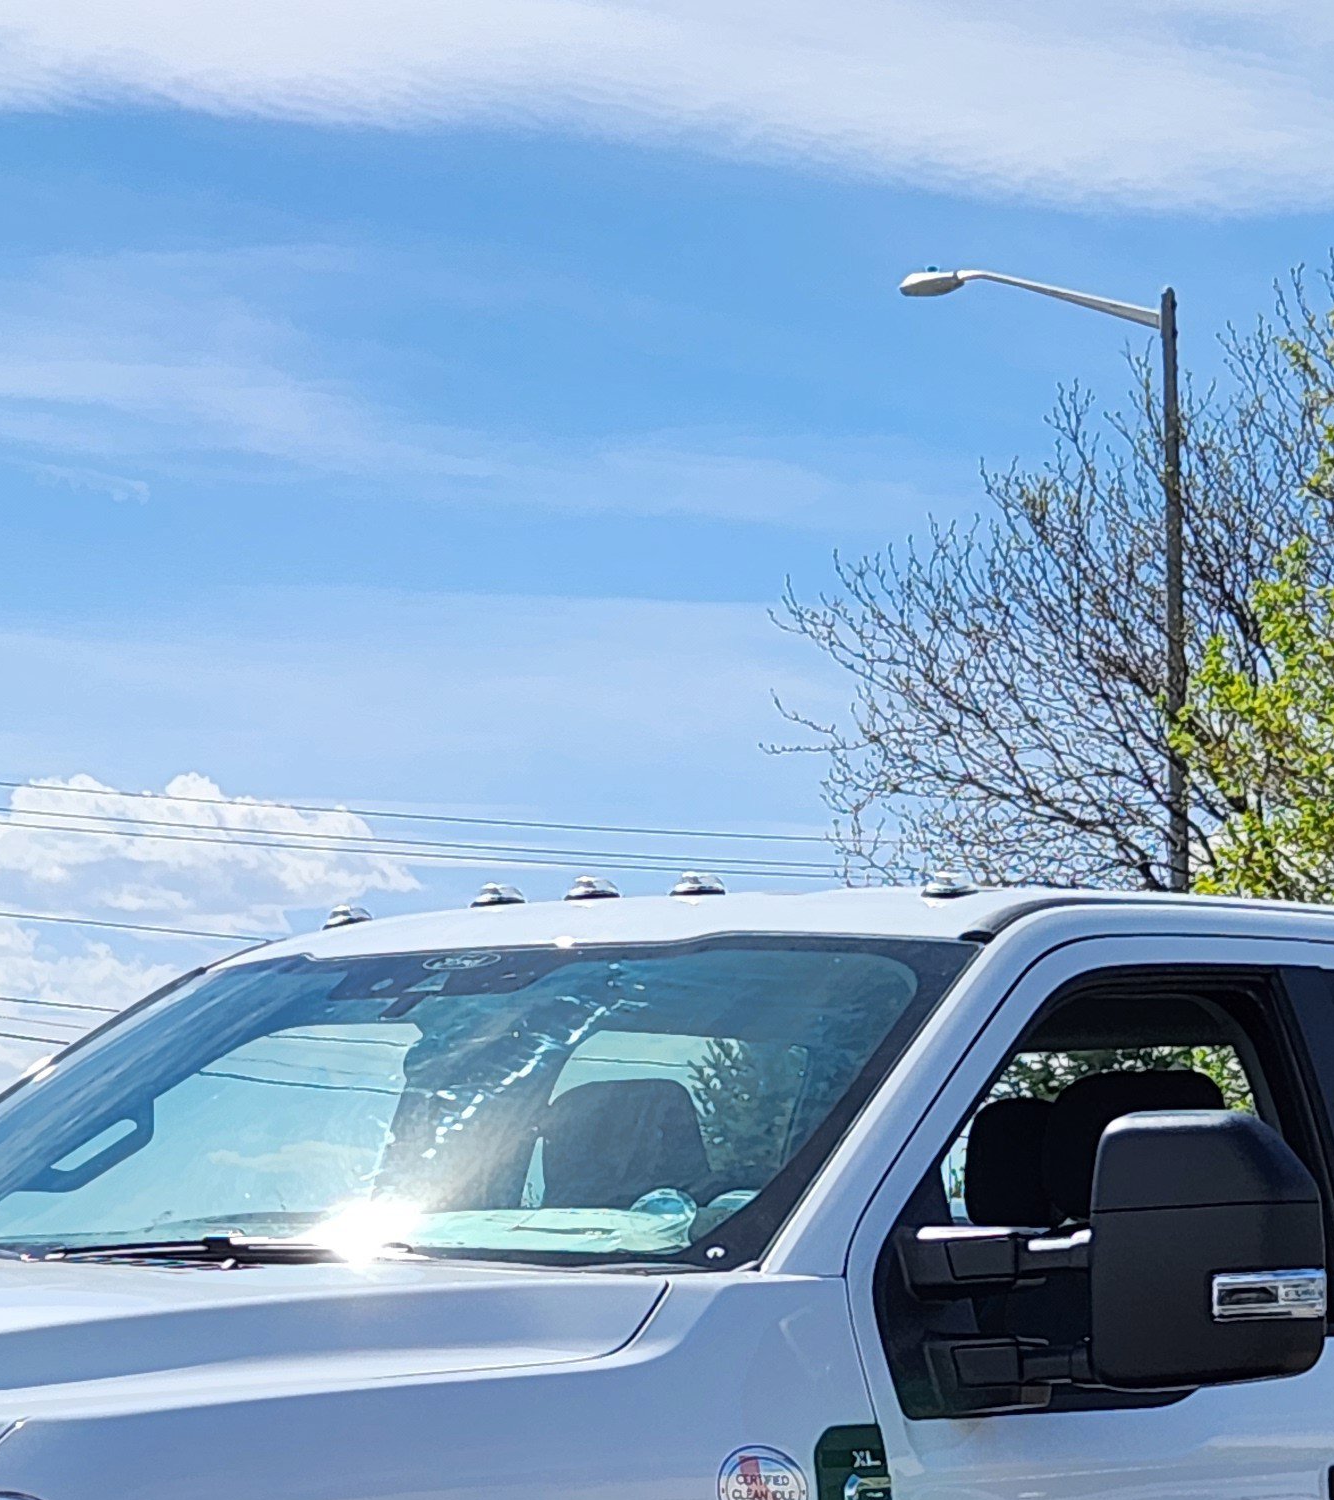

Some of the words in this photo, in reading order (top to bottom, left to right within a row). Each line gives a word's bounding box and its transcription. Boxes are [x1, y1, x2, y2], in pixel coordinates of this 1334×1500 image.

[851, 1450, 883, 1468] XL
[735, 1474, 790, 1486] CERTIFIED
[731, 1489, 768, 1500] CLEAN
